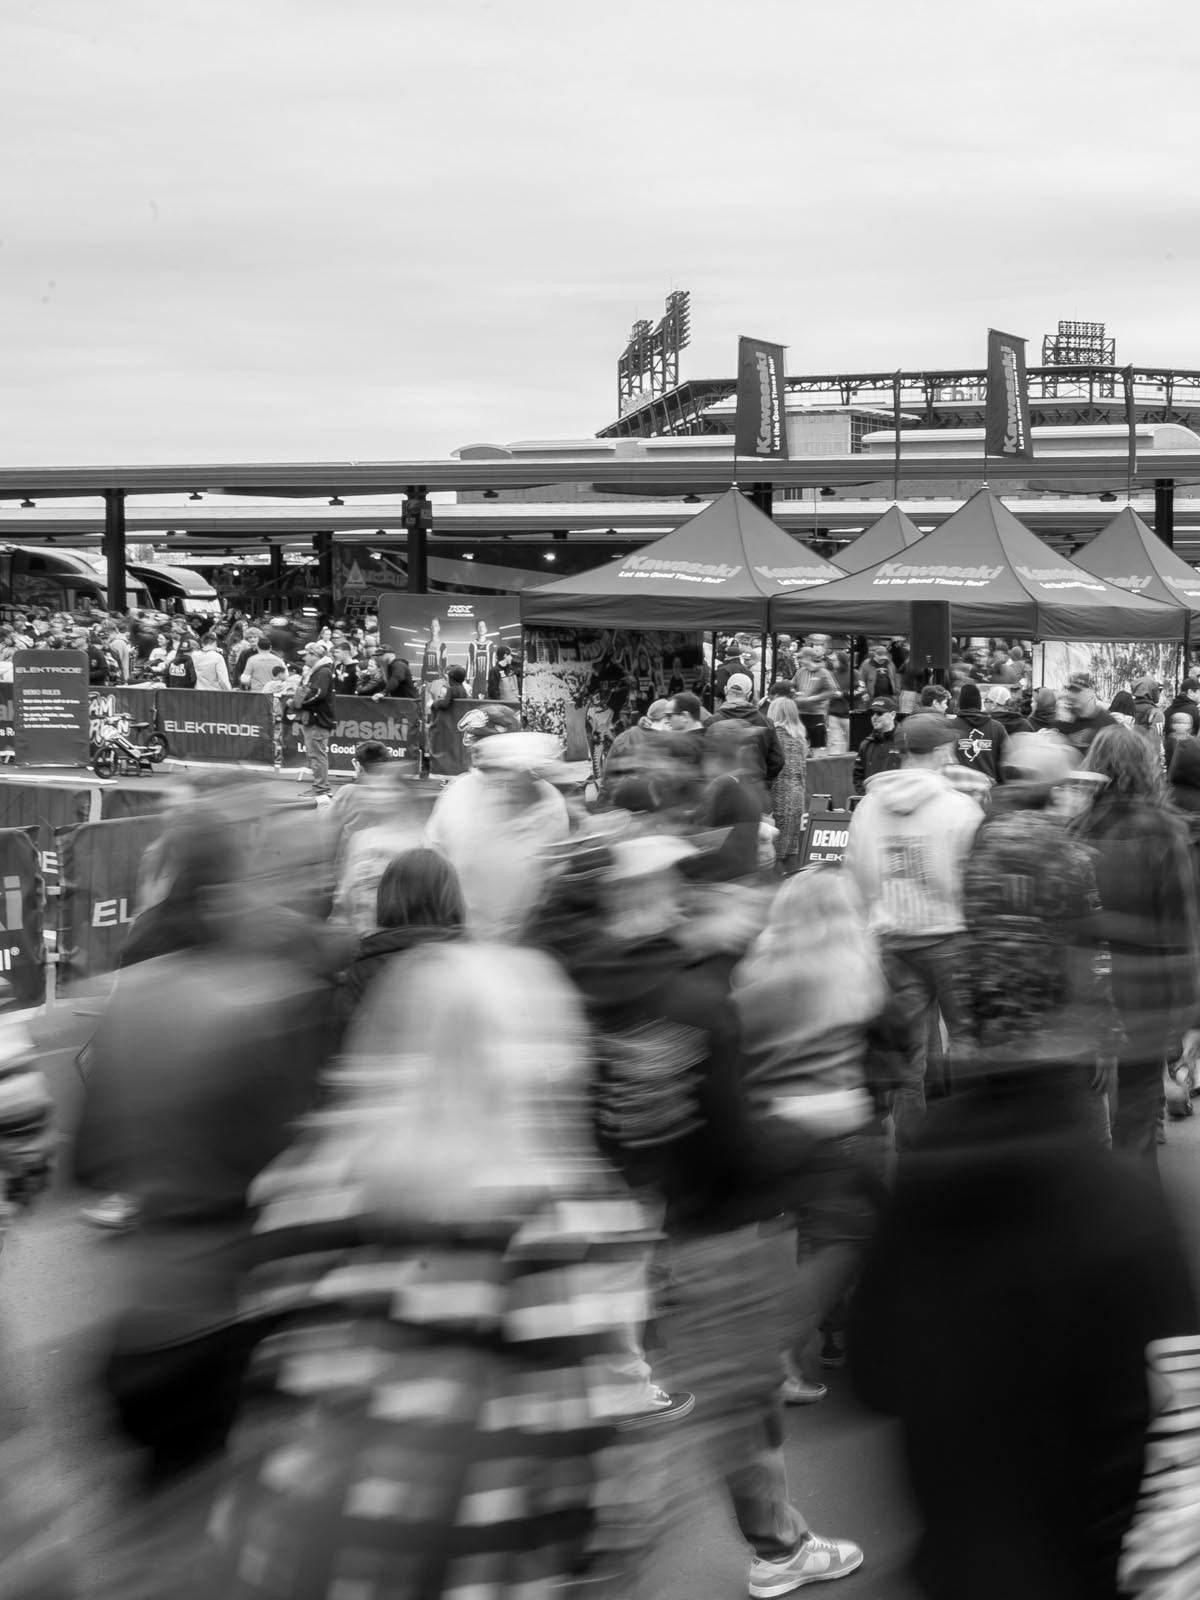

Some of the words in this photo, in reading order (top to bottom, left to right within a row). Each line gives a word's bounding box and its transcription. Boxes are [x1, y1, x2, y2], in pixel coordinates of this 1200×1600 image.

[755, 351, 771, 453] Kawasaki
[1000, 345, 1017, 453] Kawasaki
[772, 400, 780, 421] Good
[622, 556, 742, 577] Kawasaki
[875, 563, 1004, 580] Kawasaki
[15, 666, 83, 674] ELEKTRODE
[164, 720, 260, 738] ELEKTRODE
[330, 743, 356, 755] Good
[812, 829, 850, 848] DEMO
